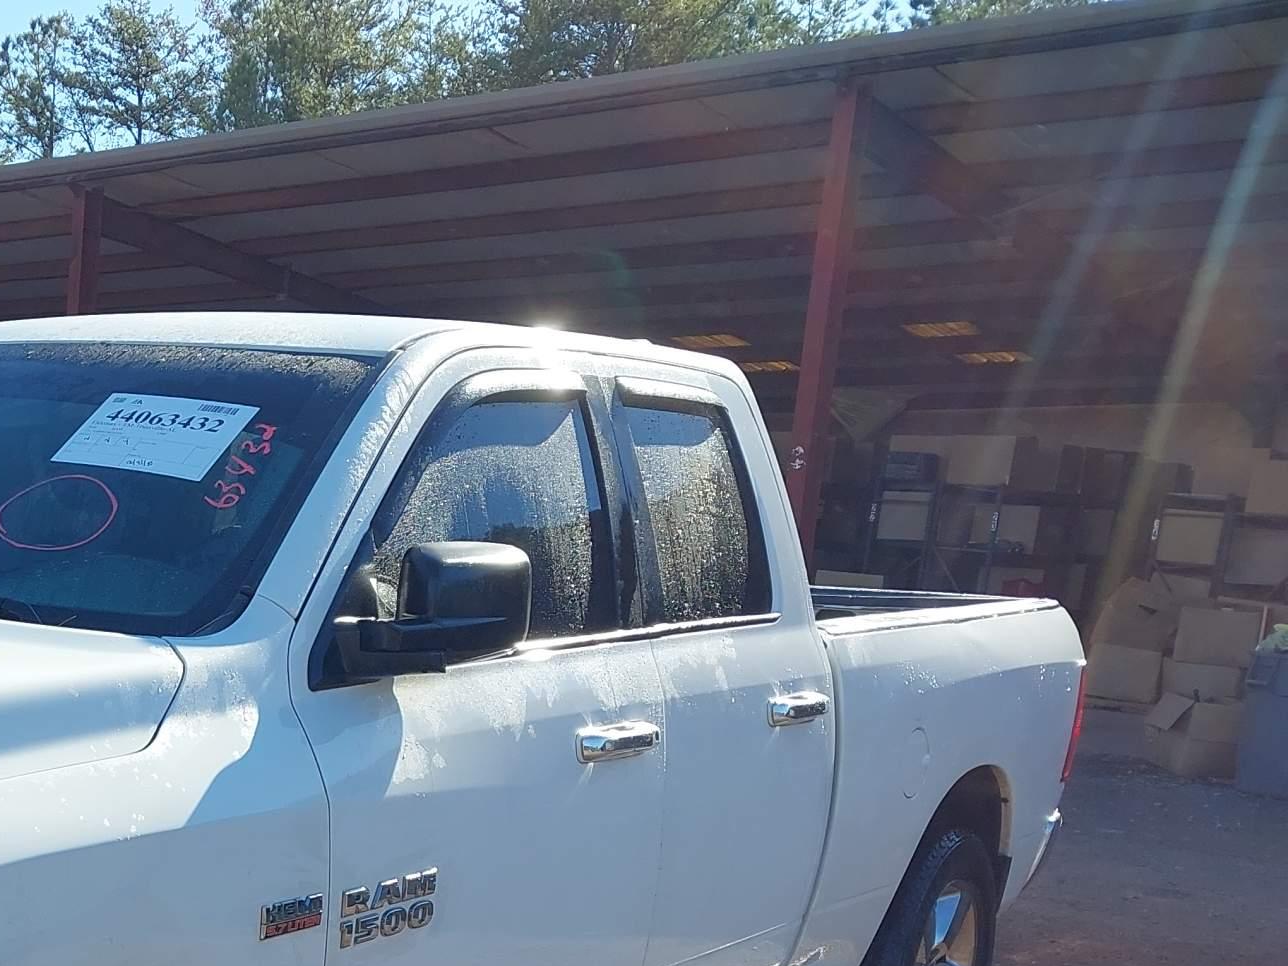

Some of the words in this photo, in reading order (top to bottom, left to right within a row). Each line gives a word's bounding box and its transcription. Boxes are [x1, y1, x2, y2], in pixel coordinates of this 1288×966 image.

[106, 408, 225, 433] 44063432
[204, 423, 278, 509] 63432
[341, 867, 438, 918] RAM
[287, 914, 322, 933] LITER
[339, 900, 434, 949] 1500
